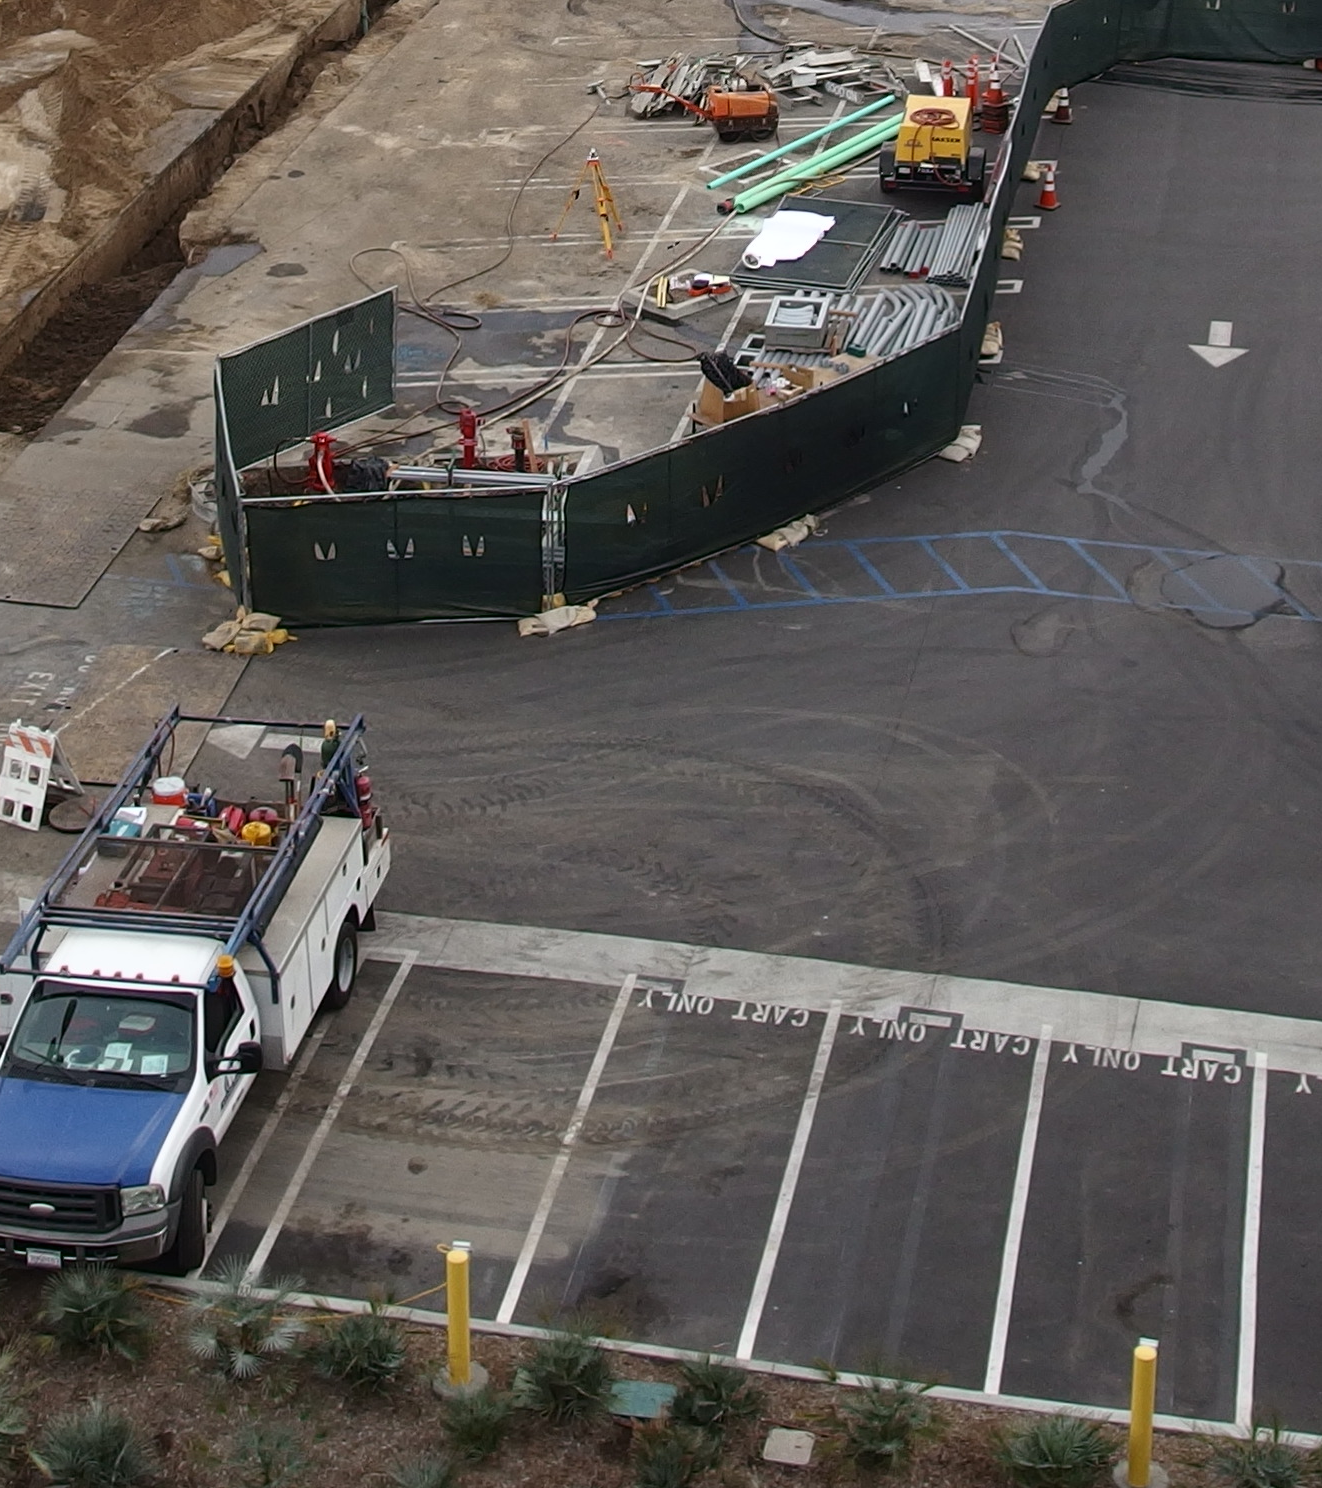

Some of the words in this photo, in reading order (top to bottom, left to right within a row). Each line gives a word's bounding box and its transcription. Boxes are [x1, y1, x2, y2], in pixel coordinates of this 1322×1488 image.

[638, 989, 714, 1015] ONLY
[732, 1001, 809, 1028] CART
[850, 1016, 927, 1043] ONLY
[950, 1029, 1031, 1057] CART
[1062, 1043, 1141, 1072] ONLY
[1160, 1055, 1242, 1085] CART
